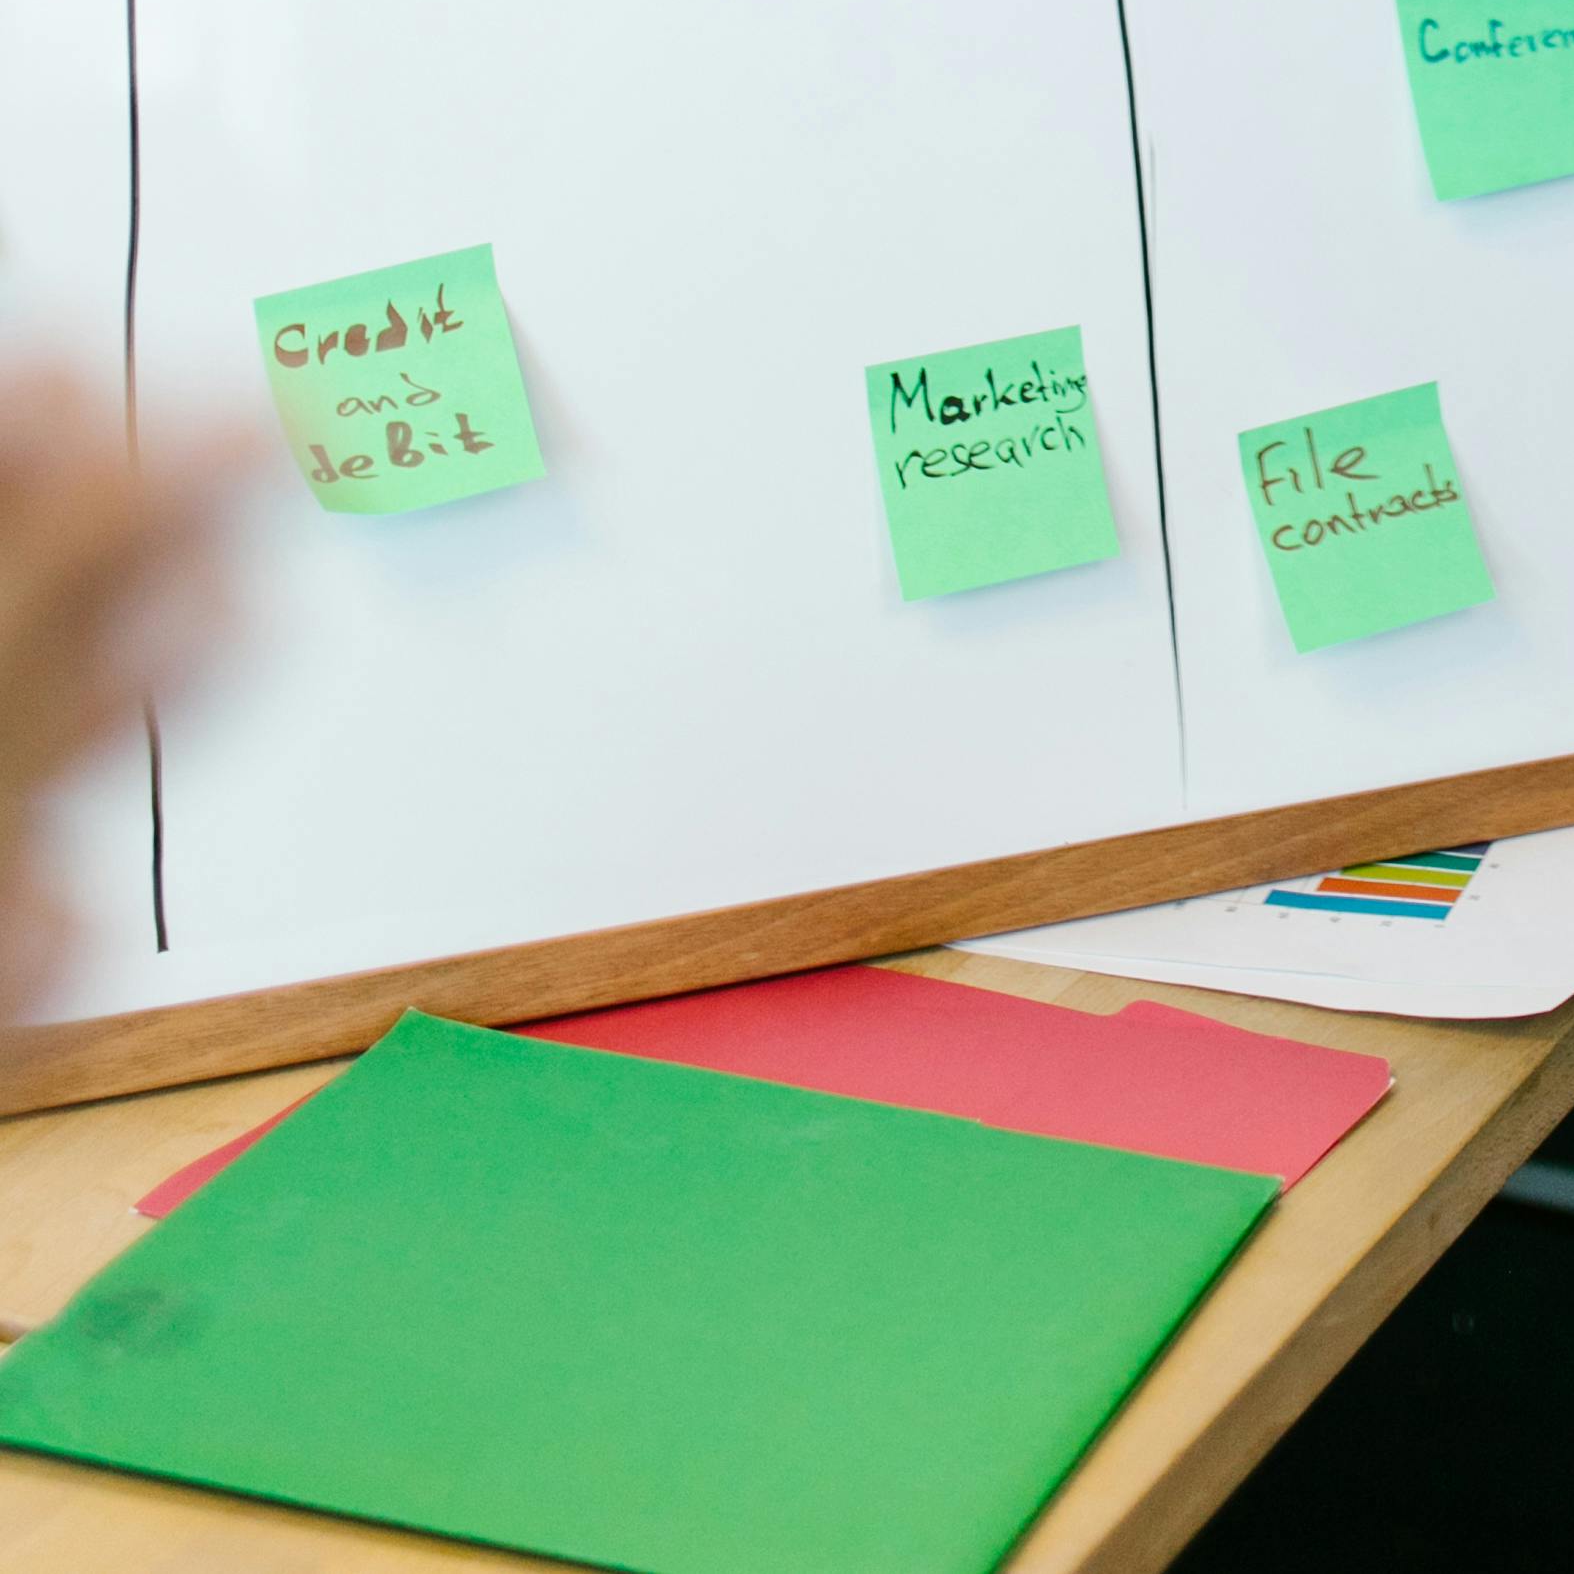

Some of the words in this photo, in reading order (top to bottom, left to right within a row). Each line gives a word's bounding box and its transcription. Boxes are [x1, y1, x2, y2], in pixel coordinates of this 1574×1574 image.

[274, 283, 465, 368] Credit
[336, 372, 442, 417] and
[890, 360, 1088, 434] Marketing
[895, 415, 1086, 490] research
[1272, 463, 1461, 551] contracts
